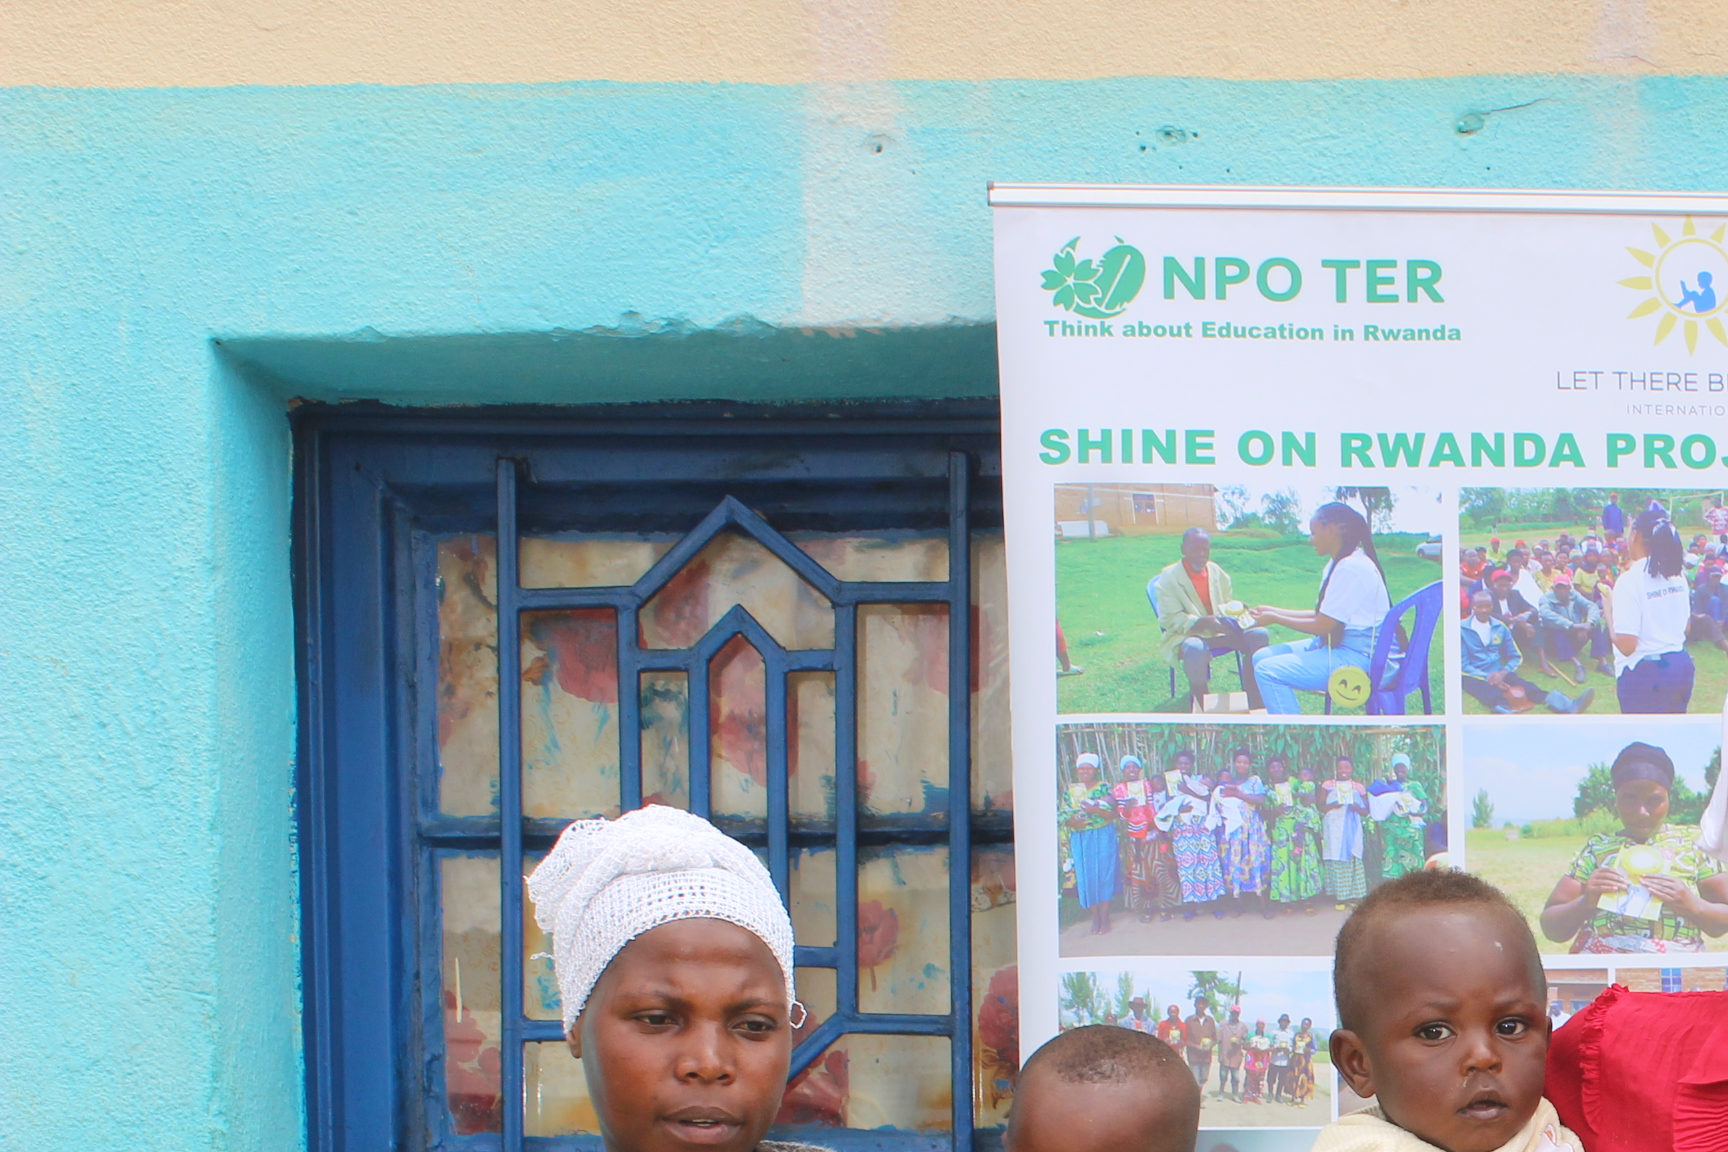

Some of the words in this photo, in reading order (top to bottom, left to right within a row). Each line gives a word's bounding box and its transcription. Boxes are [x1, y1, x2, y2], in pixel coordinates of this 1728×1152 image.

[1162, 255, 1303, 302] NPO
[1321, 258, 1445, 304] TER
[1043, 320, 1114, 338] Think
[1121, 321, 1193, 339] about
[1201, 322, 1325, 341] Education
[1332, 324, 1355, 341] in
[1363, 324, 1463, 342] Rwanda
[1556, 370, 1605, 391] LET
[1612, 371, 1699, 392] THERE
[1038, 428, 1217, 466] SHINE
[1237, 430, 1317, 468] ON
[1340, 431, 1587, 469] RWANDA
